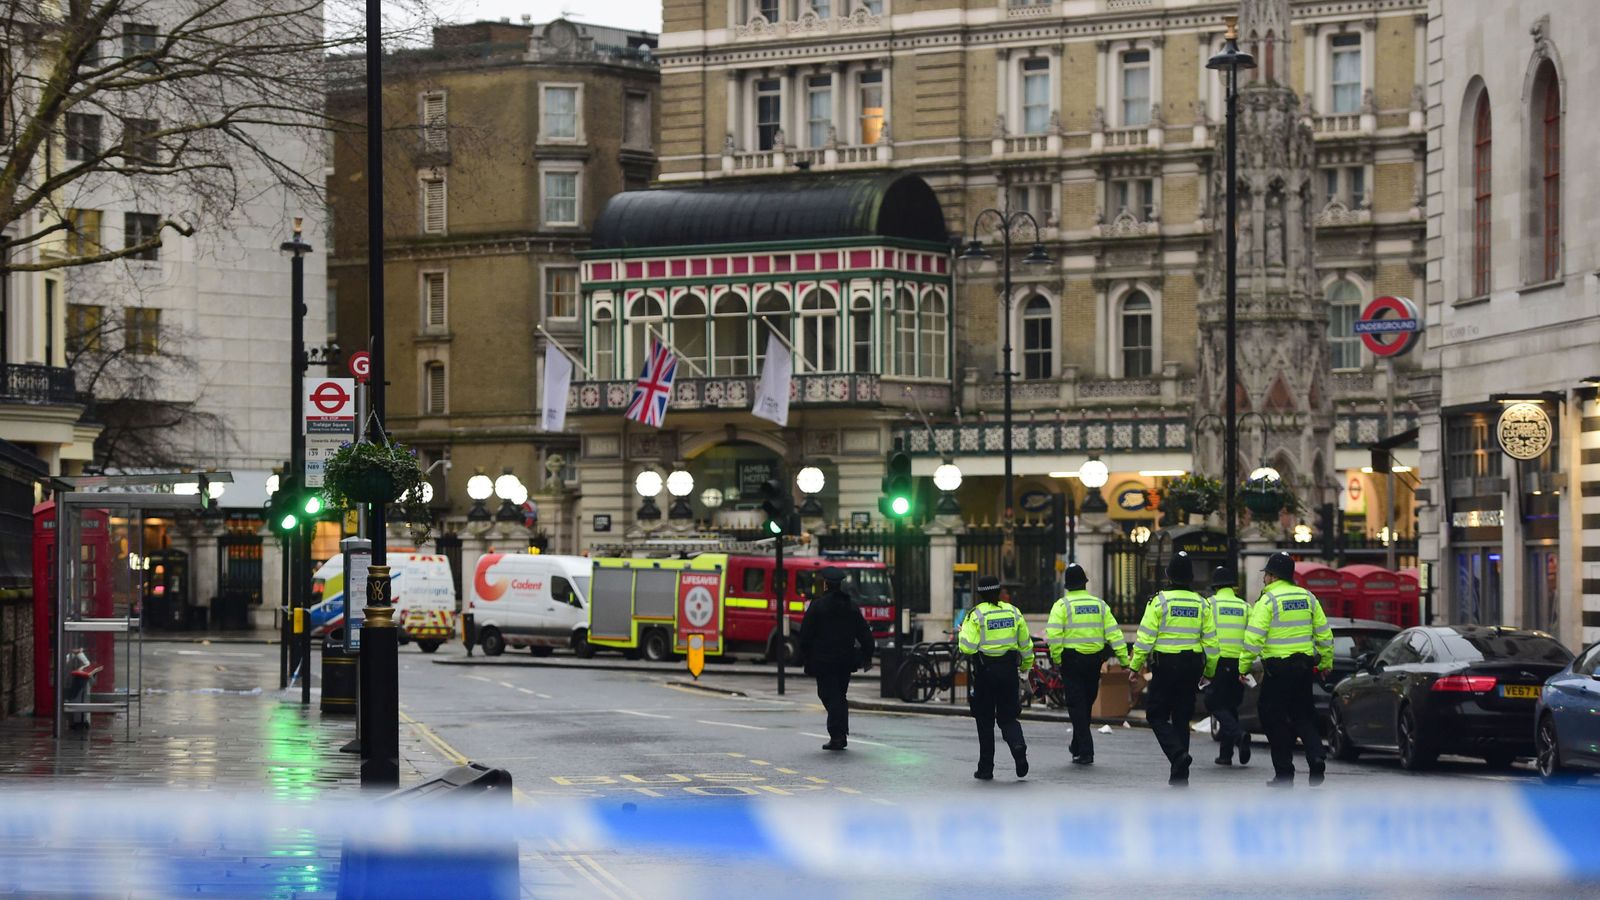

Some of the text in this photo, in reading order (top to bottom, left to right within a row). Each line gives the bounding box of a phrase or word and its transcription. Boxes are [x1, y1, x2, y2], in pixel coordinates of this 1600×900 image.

[1355, 320, 1415, 331] UNDERGROUND
[353, 356, 369, 375] G
[743, 464, 770, 472] AMBA
[511, 578, 543, 590] Cadent
[682, 575, 718, 585] LIFESAVER
[1075, 606, 1099, 614] POLICE
[1284, 601, 1308, 611] POLICE
[1171, 608, 1198, 618] POLICE
[1219, 608, 1244, 616] POLICE
[987, 620, 1014, 630] POLICE
[1505, 685, 1531, 696] VE67
[551, 773, 766, 785] BUS
